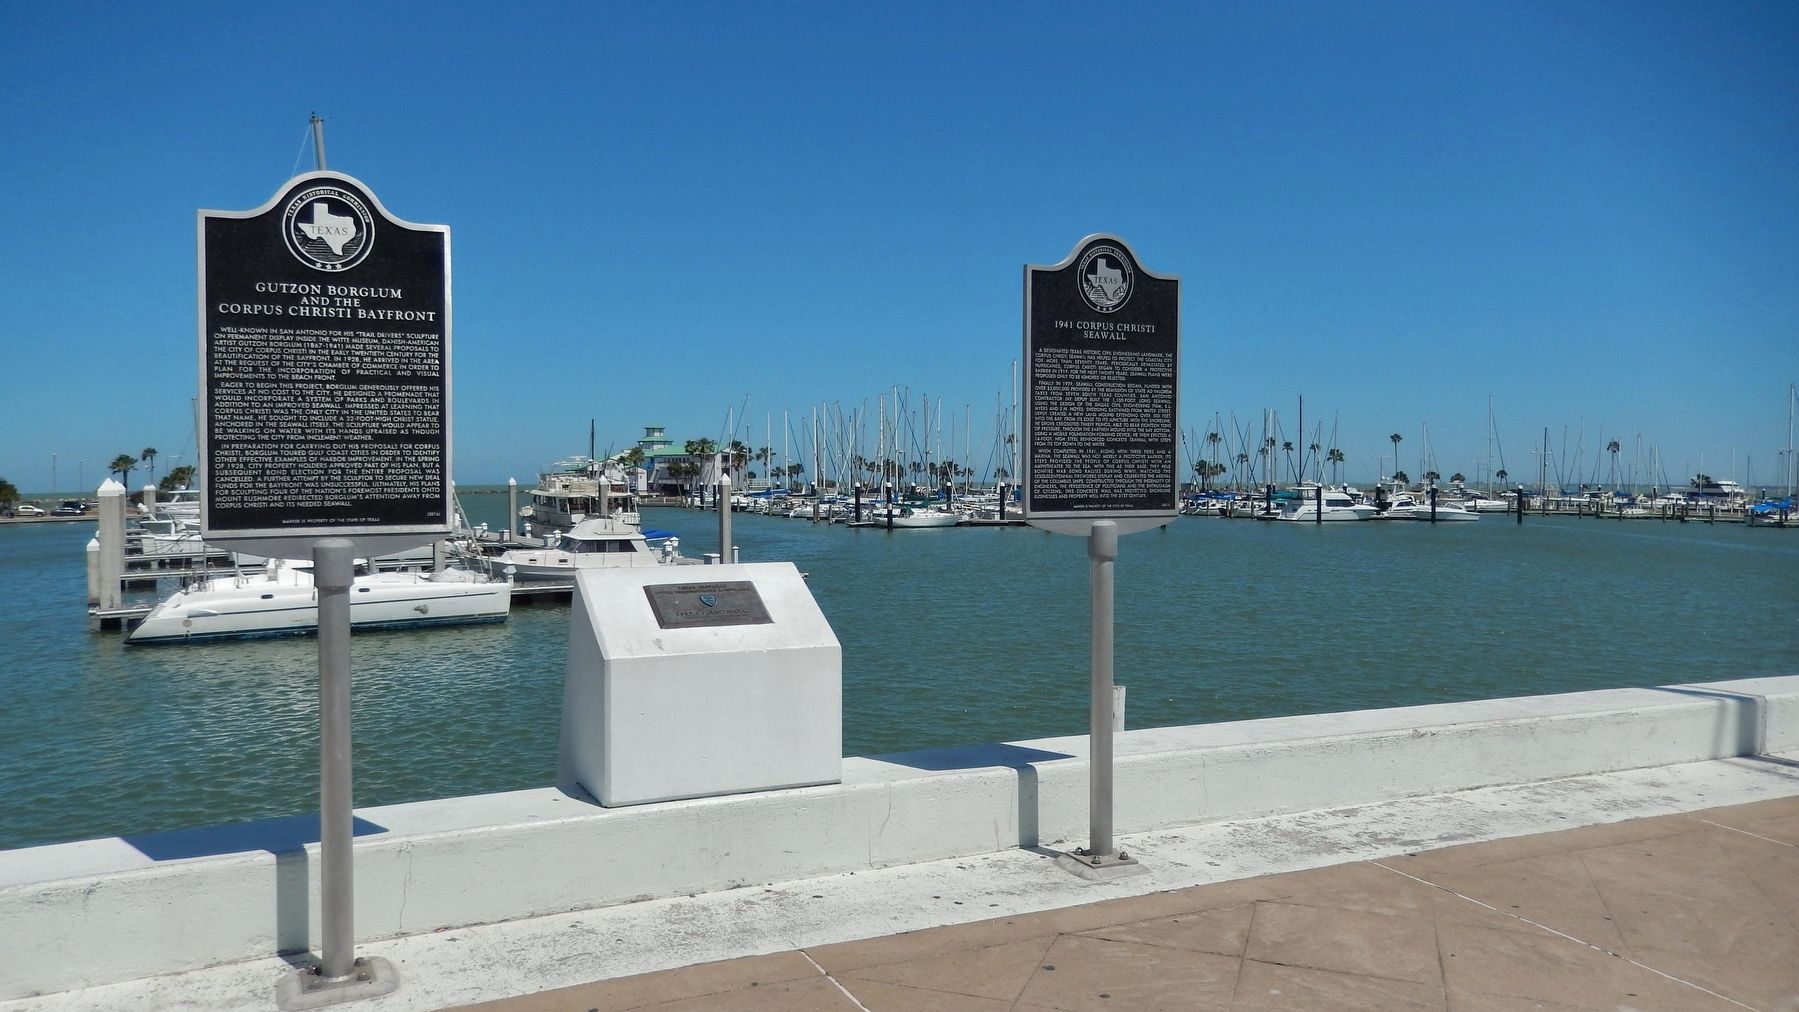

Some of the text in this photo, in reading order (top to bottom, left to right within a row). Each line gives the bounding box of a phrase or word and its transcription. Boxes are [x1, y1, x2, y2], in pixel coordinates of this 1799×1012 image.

[303, 190, 339, 200] HISTORICAL
[342, 194, 370, 223] COMMISSION
[310, 226, 348, 236] TEXAS
[256, 282, 402, 299] GUTZON BORGLUM
[301, 296, 361, 307] AND THE
[219, 303, 436, 321] CORPUS CHRISTI BAYFRONT
[1055, 320, 1155, 333] 1941 CORPUS CHRISTI
[1084, 331, 1126, 340] SEAWALL
